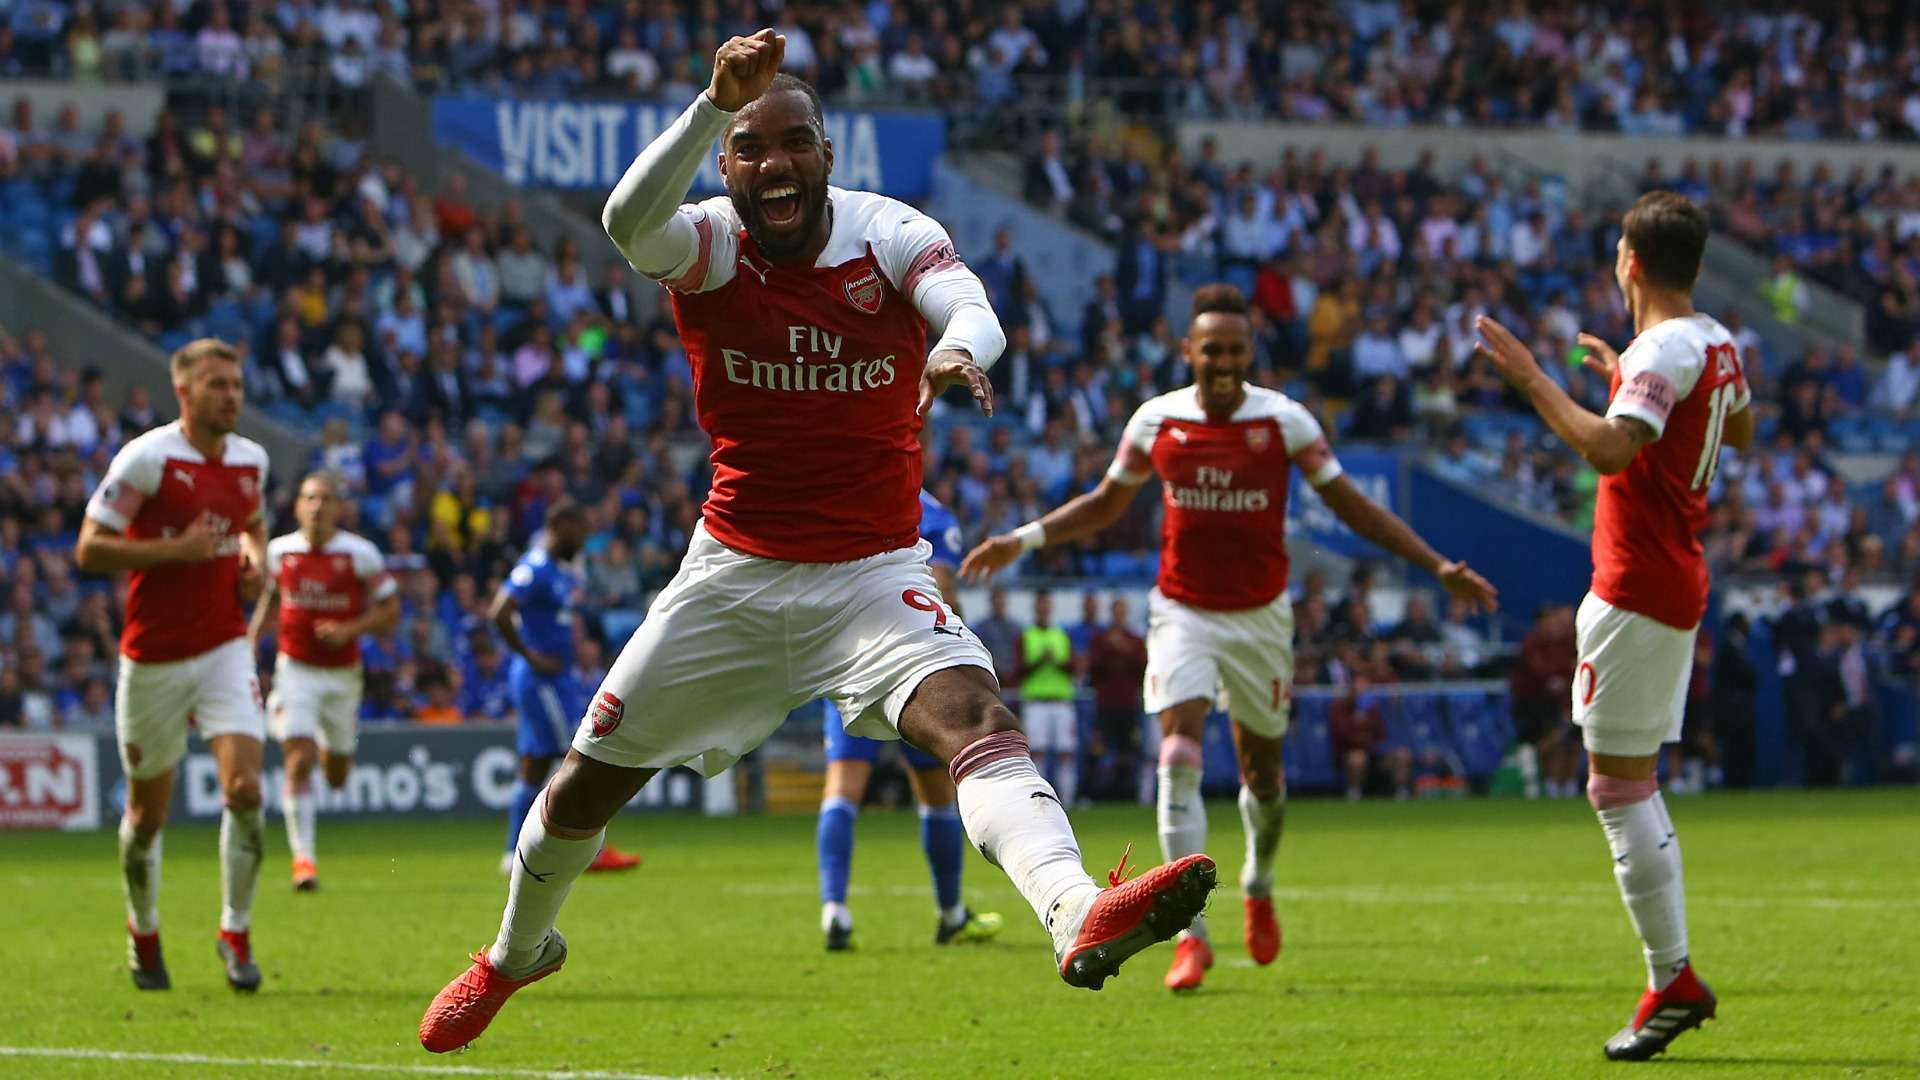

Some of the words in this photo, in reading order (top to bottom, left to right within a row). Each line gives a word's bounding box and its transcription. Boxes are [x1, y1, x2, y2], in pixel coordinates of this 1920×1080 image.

[496, 101, 627, 187] VISIT
[848, 271, 876, 290] Arsenal
[788, 326, 842, 359] Fly
[721, 349, 895, 393] Emirates
[1197, 466, 1233, 489] Fly
[901, 588, 946, 628] 9
[186, 745, 459, 813] Dno's
